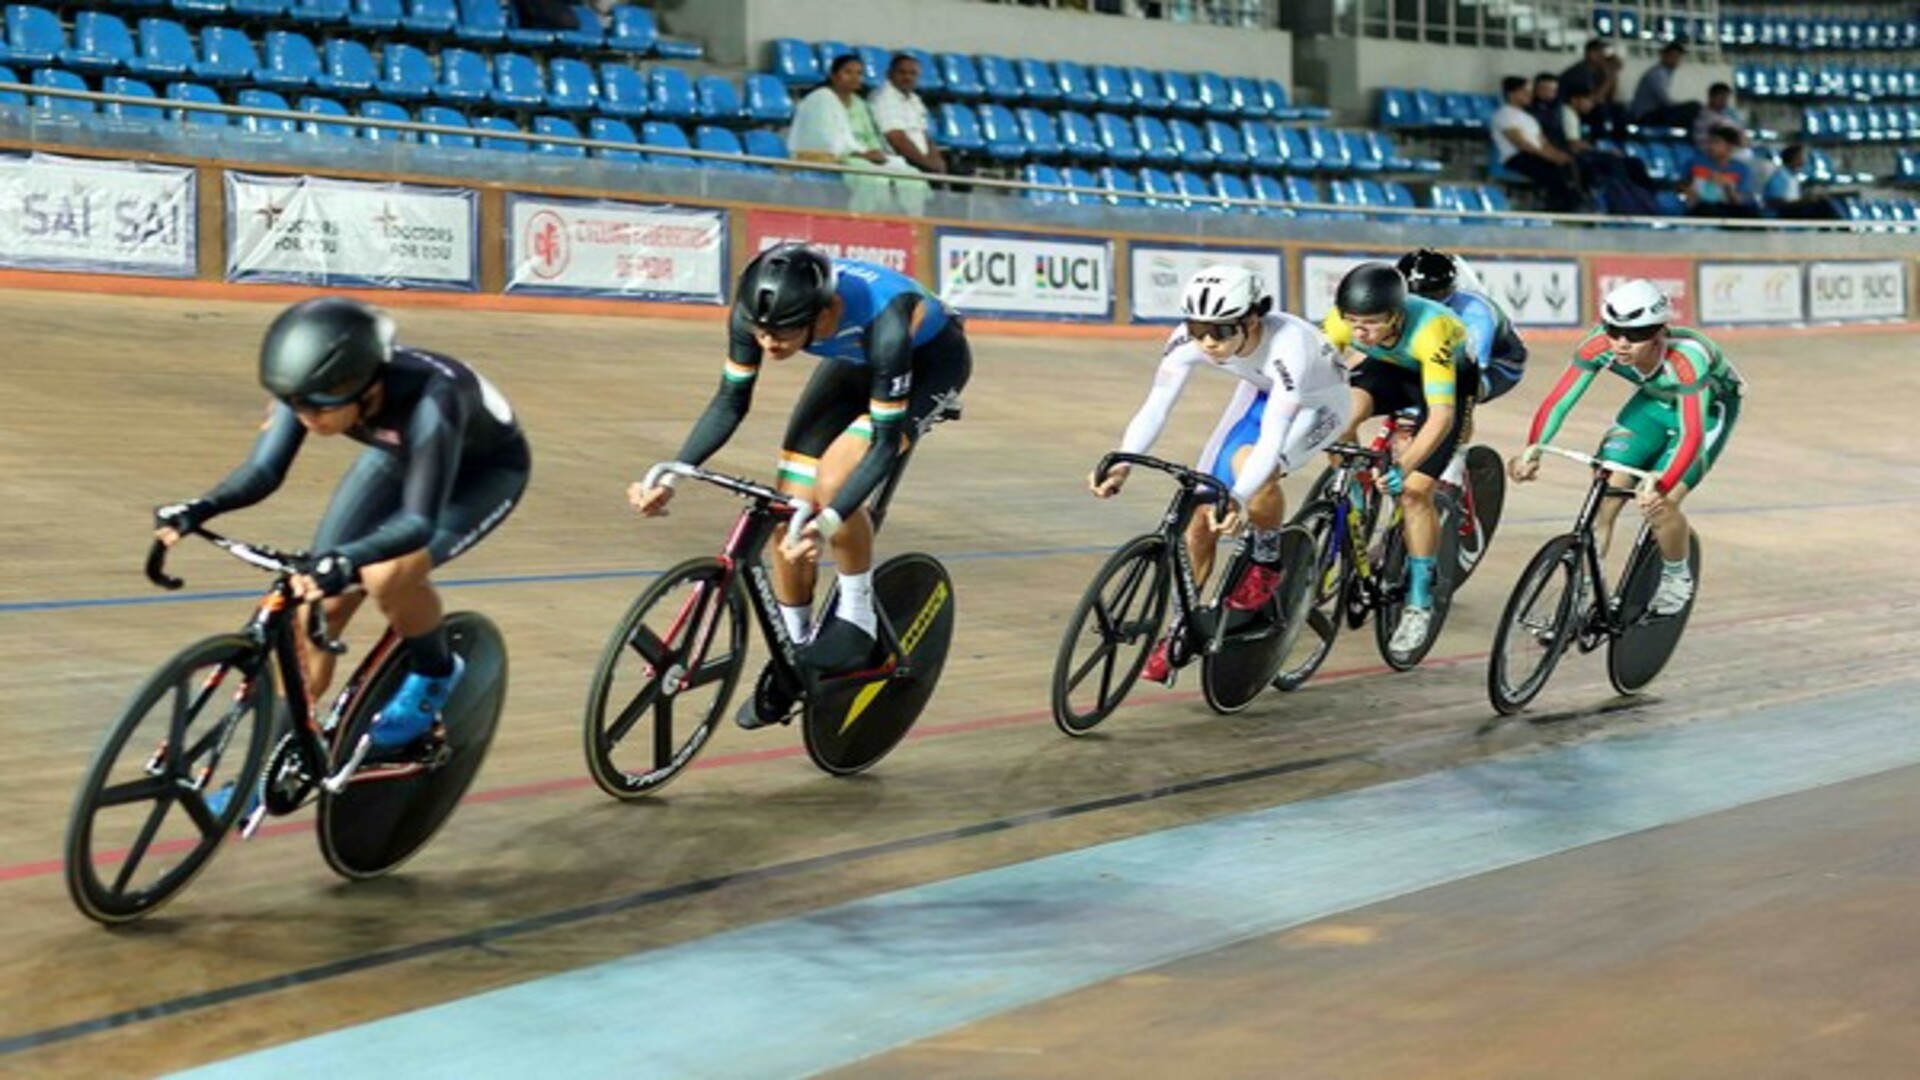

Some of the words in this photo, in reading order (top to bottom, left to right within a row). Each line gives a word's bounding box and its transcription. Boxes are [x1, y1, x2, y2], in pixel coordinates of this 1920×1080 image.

[22, 193, 91, 237] SAI
[962, 250, 1016, 287] UCI
[1050, 256, 1100, 292] UCI
